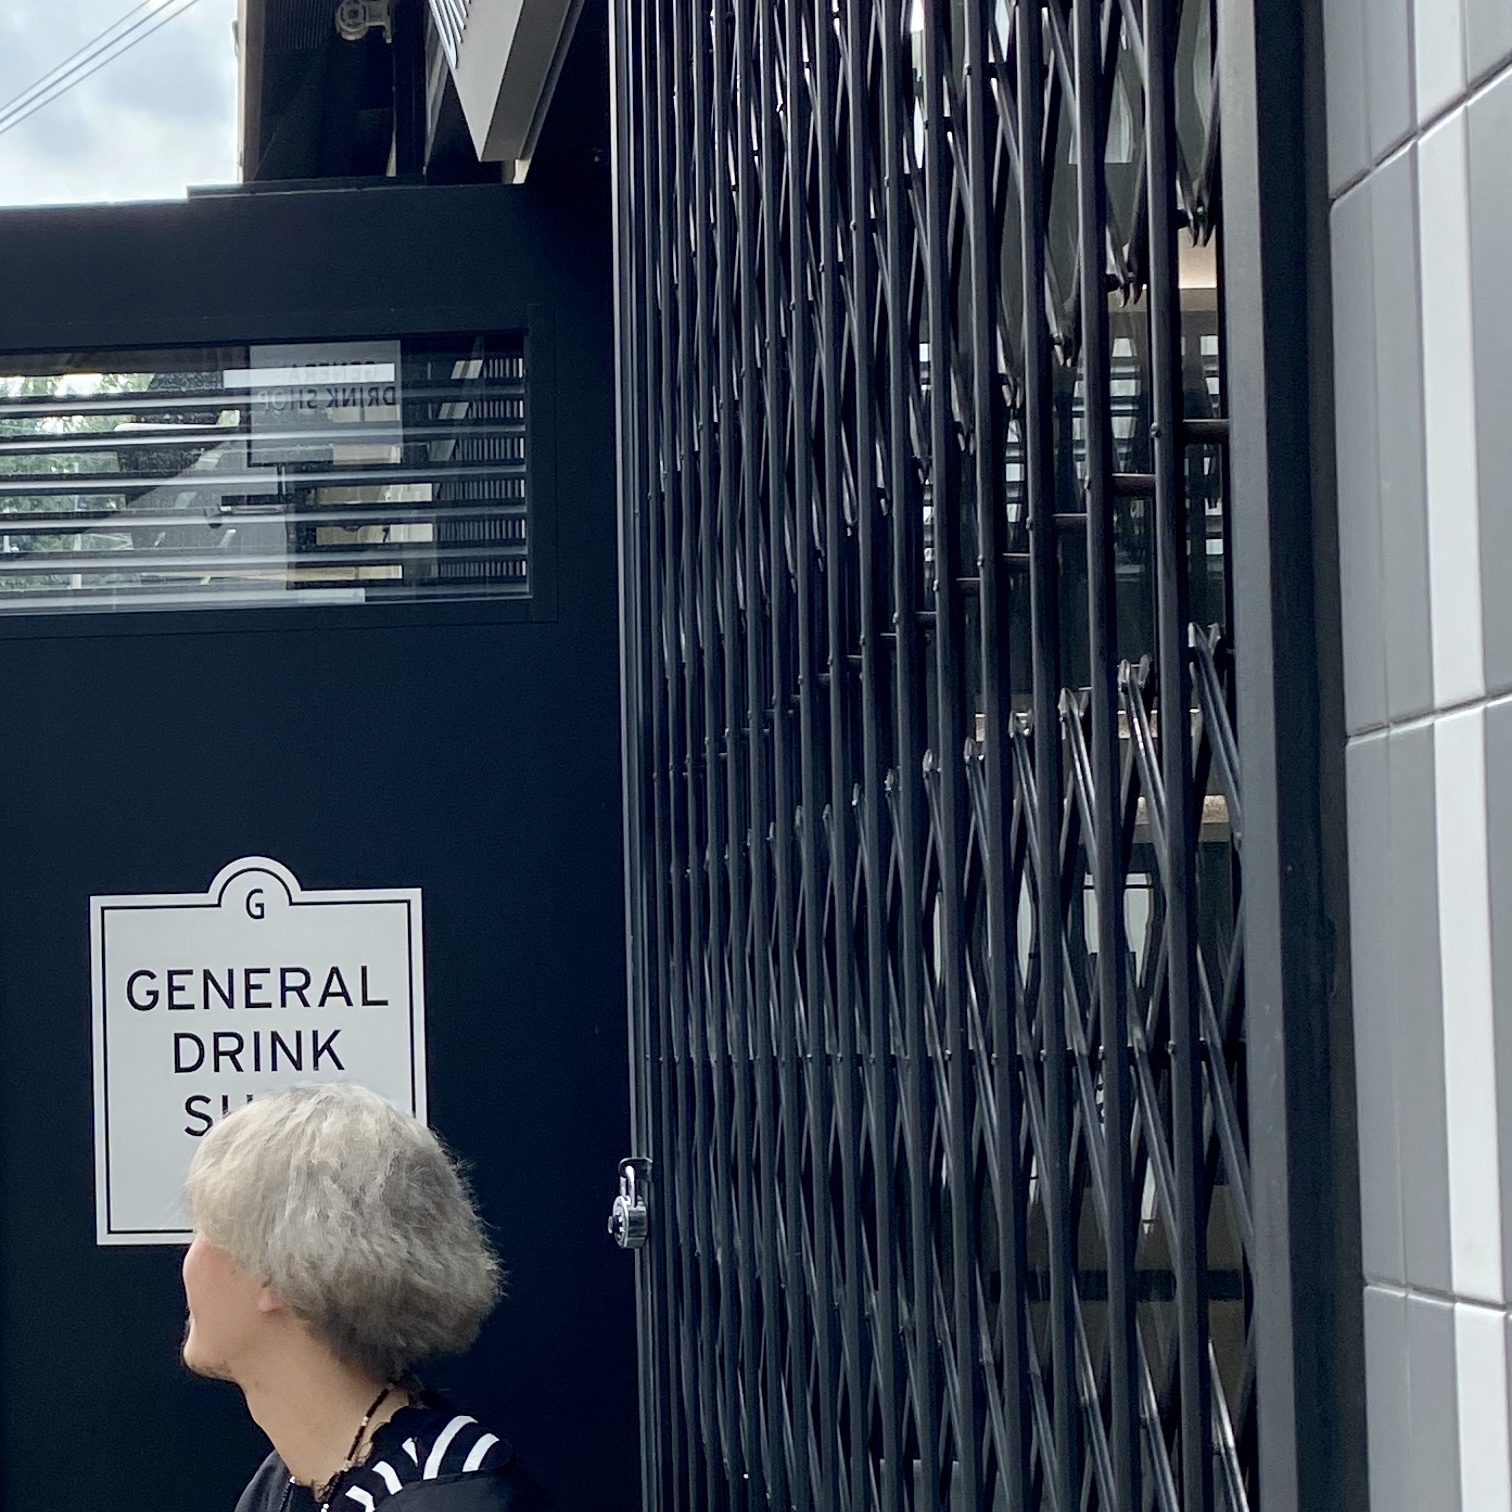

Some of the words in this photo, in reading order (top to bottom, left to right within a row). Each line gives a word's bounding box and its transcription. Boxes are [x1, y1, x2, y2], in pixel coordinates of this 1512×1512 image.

[246, 888, 265, 919] G
[126, 965, 389, 1011] GENERAL
[173, 1029, 345, 1074] DRINK
